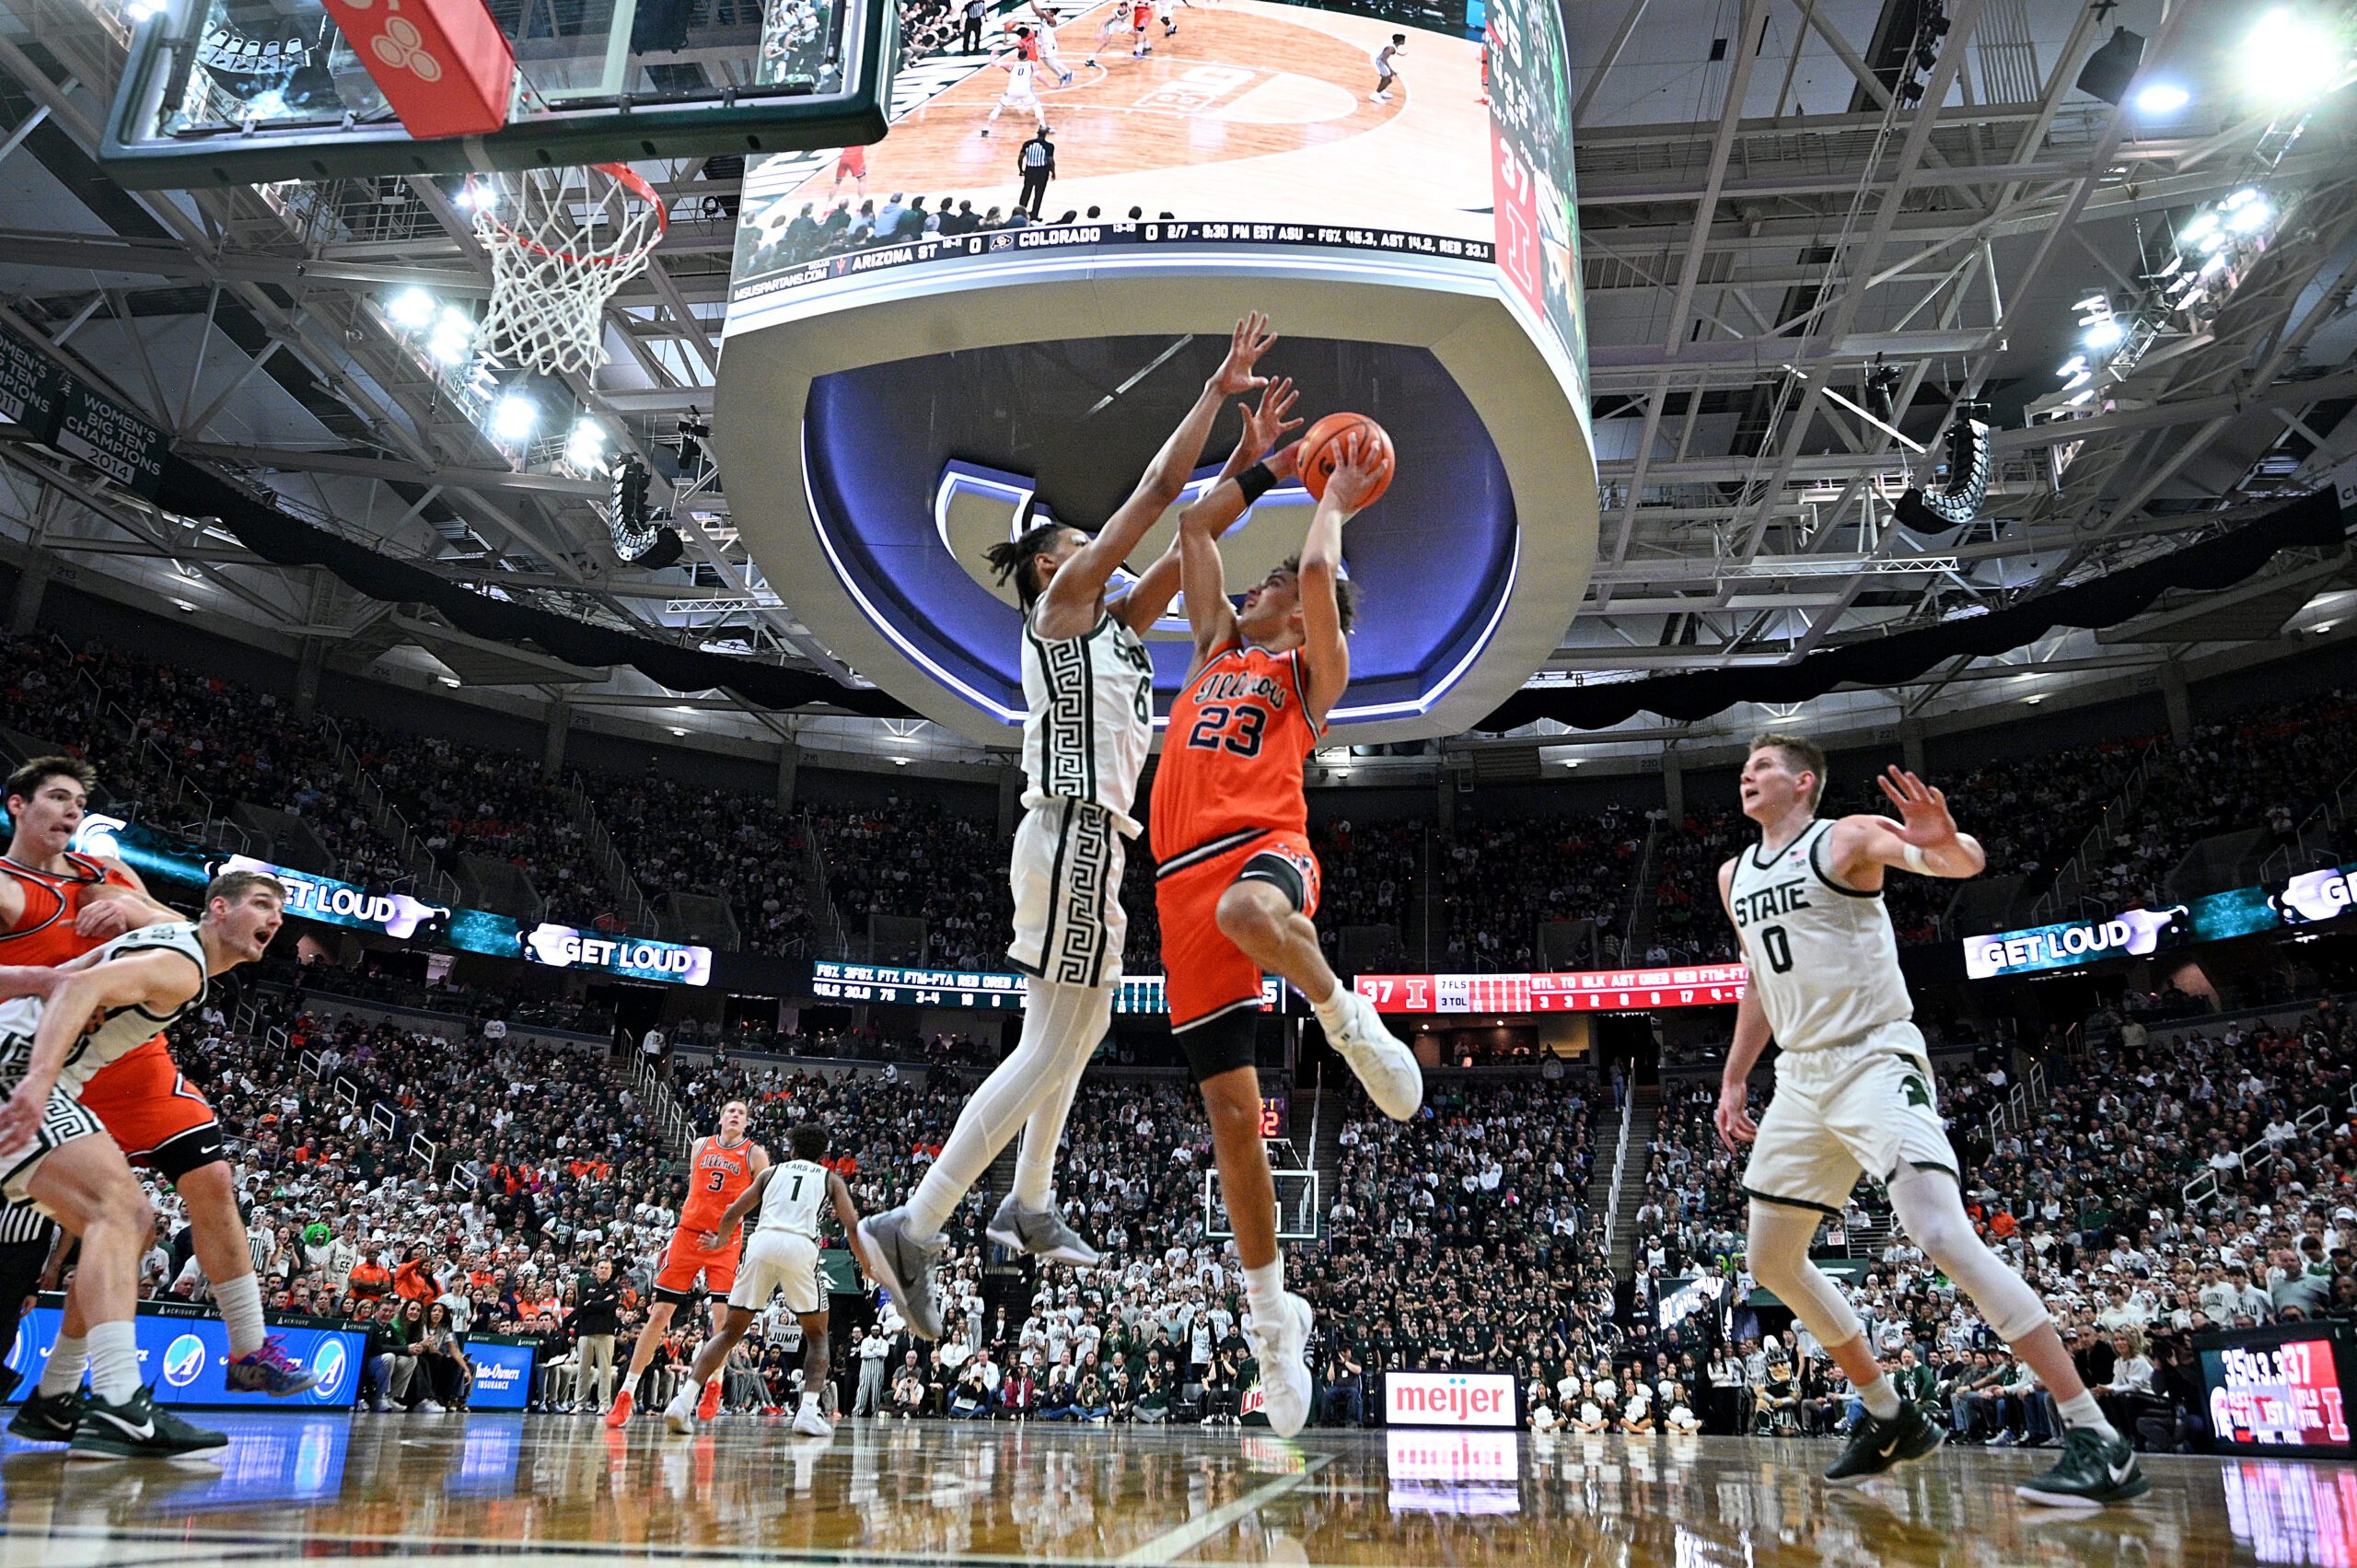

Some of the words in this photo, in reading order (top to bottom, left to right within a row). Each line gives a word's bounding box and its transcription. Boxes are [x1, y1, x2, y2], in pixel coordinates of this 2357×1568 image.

[1500, 137, 1529, 206] 37
[1019, 227, 1101, 248] COLORADO
[1145, 224, 1158, 241] 0
[1167, 224, 1190, 239] 2/7
[1232, 225, 1250, 239] PM
[1253, 225, 1275, 239] EST
[1278, 226, 1304, 240] ASU
[1381, 234, 1406, 249] AST
[1439, 239, 1462, 254] REB
[852, 249, 913, 272] ARIZONA
[917, 243, 938, 260] ST
[969, 237, 981, 254] 0
[734, 268, 828, 301] MSUSPARTANS.COM
[0, 336, 47, 378] MEN'S
[10, 360, 37, 388] TEN
[84, 393, 157, 444] WOMEN'S
[87, 412, 113, 435] BIG
[119, 428, 147, 454] TEN
[65, 416, 161, 475] CHAMPIONS
[87, 447, 128, 479] 2014
[1133, 676, 1151, 726] 6
[1193, 670, 1286, 710] Illinois
[1186, 704, 1268, 759] 23
[278, 876, 314, 908] ET
[316, 885, 396, 923] LOUD
[1734, 877, 1812, 928] STATE
[558, 935, 616, 966] GET
[619, 944, 692, 973] LOUD
[1762, 924, 1794, 974] 0
[1980, 936, 2044, 968] GET
[2047, 919, 2131, 959] LOUD
[877, 970, 900, 983] FT%
[904, 971, 954, 986] FTM-FTA
[1015, 977, 1028, 990] AS
[1262, 981, 1277, 1004] 5
[1362, 981, 1394, 1003] 37
[1532, 977, 1556, 990] STL
[1560, 976, 1576, 989] TO
[1582, 973, 1606, 988] BLK
[1611, 973, 1635, 987] AST
[879, 989, 896, 1001] 75
[915, 991, 940, 1005] 3-4
[1441, 998, 1447, 1006] 3
[1450, 998, 1468, 1006] TOL
[1539, 995, 1550, 1008] 3
[1564, 995, 1574, 1007] 3
[1680, 990, 1694, 1004] 17
[700, 1155, 740, 1175] Illinois
[708, 1171, 725, 1191] 3
[790, 1175, 803, 1202] 1
[558, 1235, 566, 1245] 10
[339, 1260, 351, 1274] 55
[770, 1332, 799, 1344] JUMP
[2222, 1349, 2247, 1387] 35
[2285, 1344, 2311, 1384] 37
[477, 1381, 509, 1390] INSURANCE
[1396, 1377, 1504, 1421] meijer
